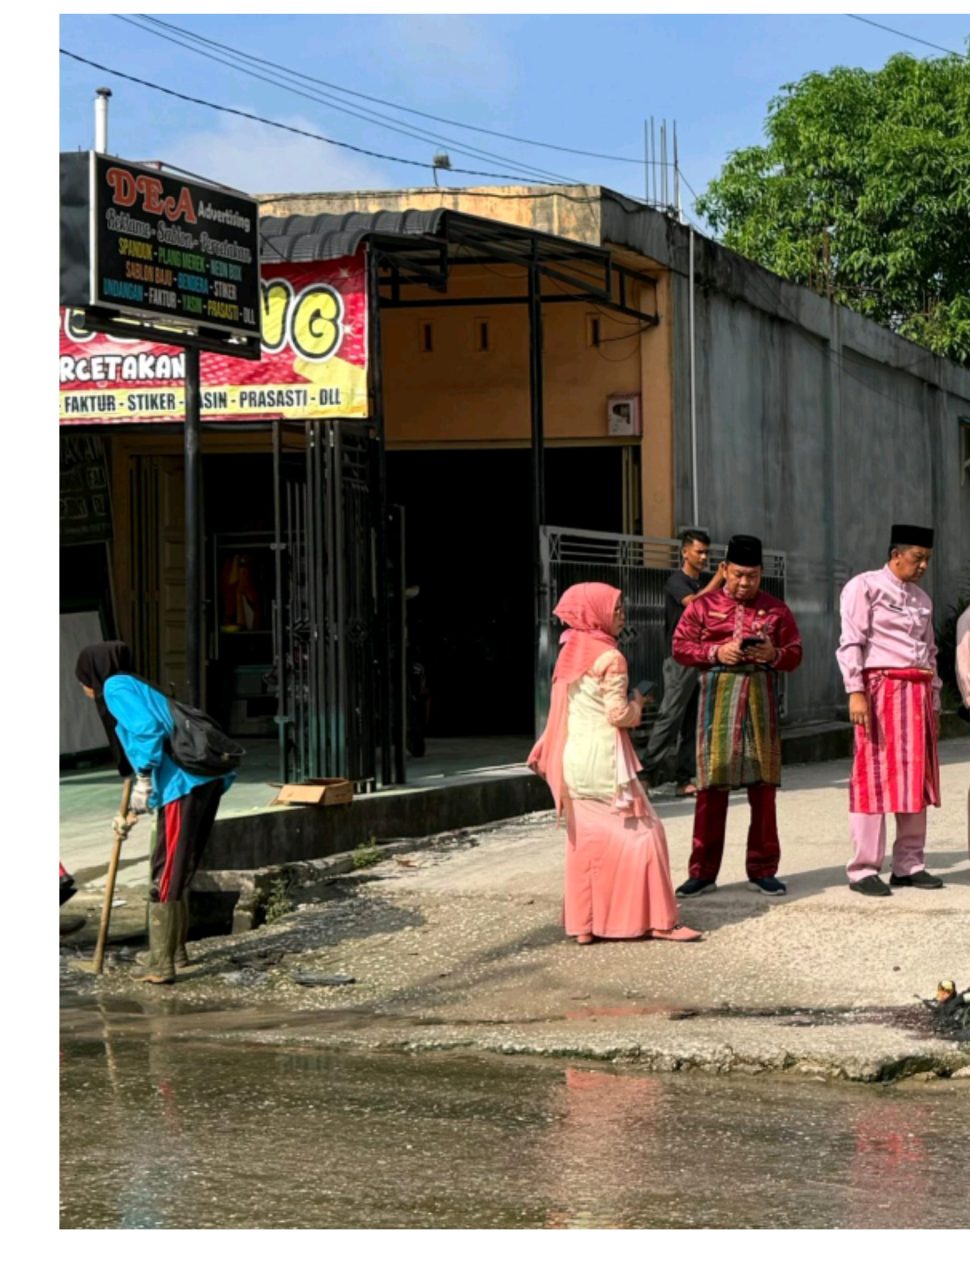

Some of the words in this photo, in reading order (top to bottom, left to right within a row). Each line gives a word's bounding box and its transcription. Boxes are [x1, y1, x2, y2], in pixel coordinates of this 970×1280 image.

[106, 167, 198, 224] DEA
[198, 200, 251, 233] Advertising
[148, 286, 177, 309] FAKTUR
[207, 298, 240, 321] PRASASTI
[214, 279, 238, 301] STIKER
[60, 351, 187, 383] RCETAKAN
[64, 393, 116, 413] FAKTUR
[127, 392, 176, 411] STIKER
[239, 389, 307, 408] PRASASTI
[319, 388, 341, 406] DLL
